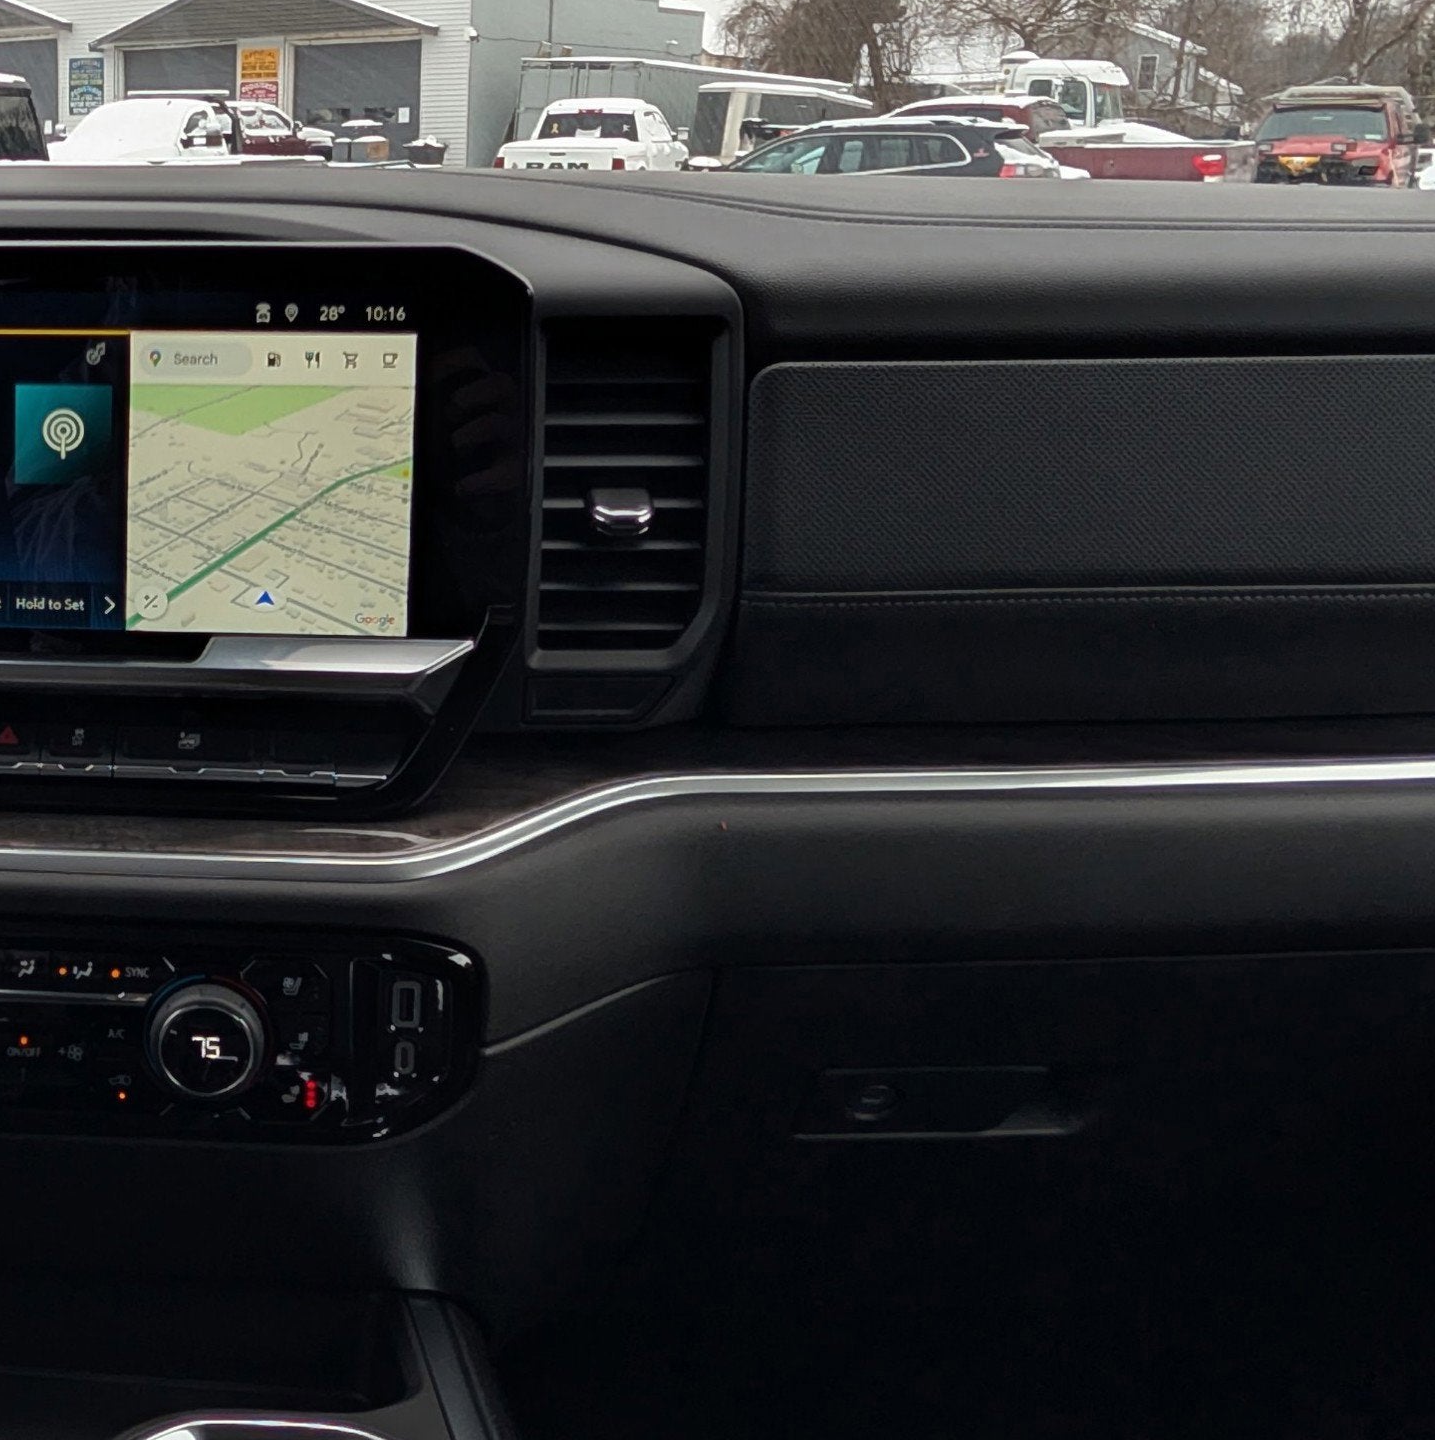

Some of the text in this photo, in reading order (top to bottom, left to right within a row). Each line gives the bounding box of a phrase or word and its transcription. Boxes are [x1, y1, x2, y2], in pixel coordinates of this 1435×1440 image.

[365, 305, 406, 322] 10:16
[174, 352, 219, 366] Search
[15, 597, 85, 611] Hold to Set
[354, 612, 396, 633] Google
[125, 966, 149, 979] SYNC
[191, 1036, 220, 1059] 75
